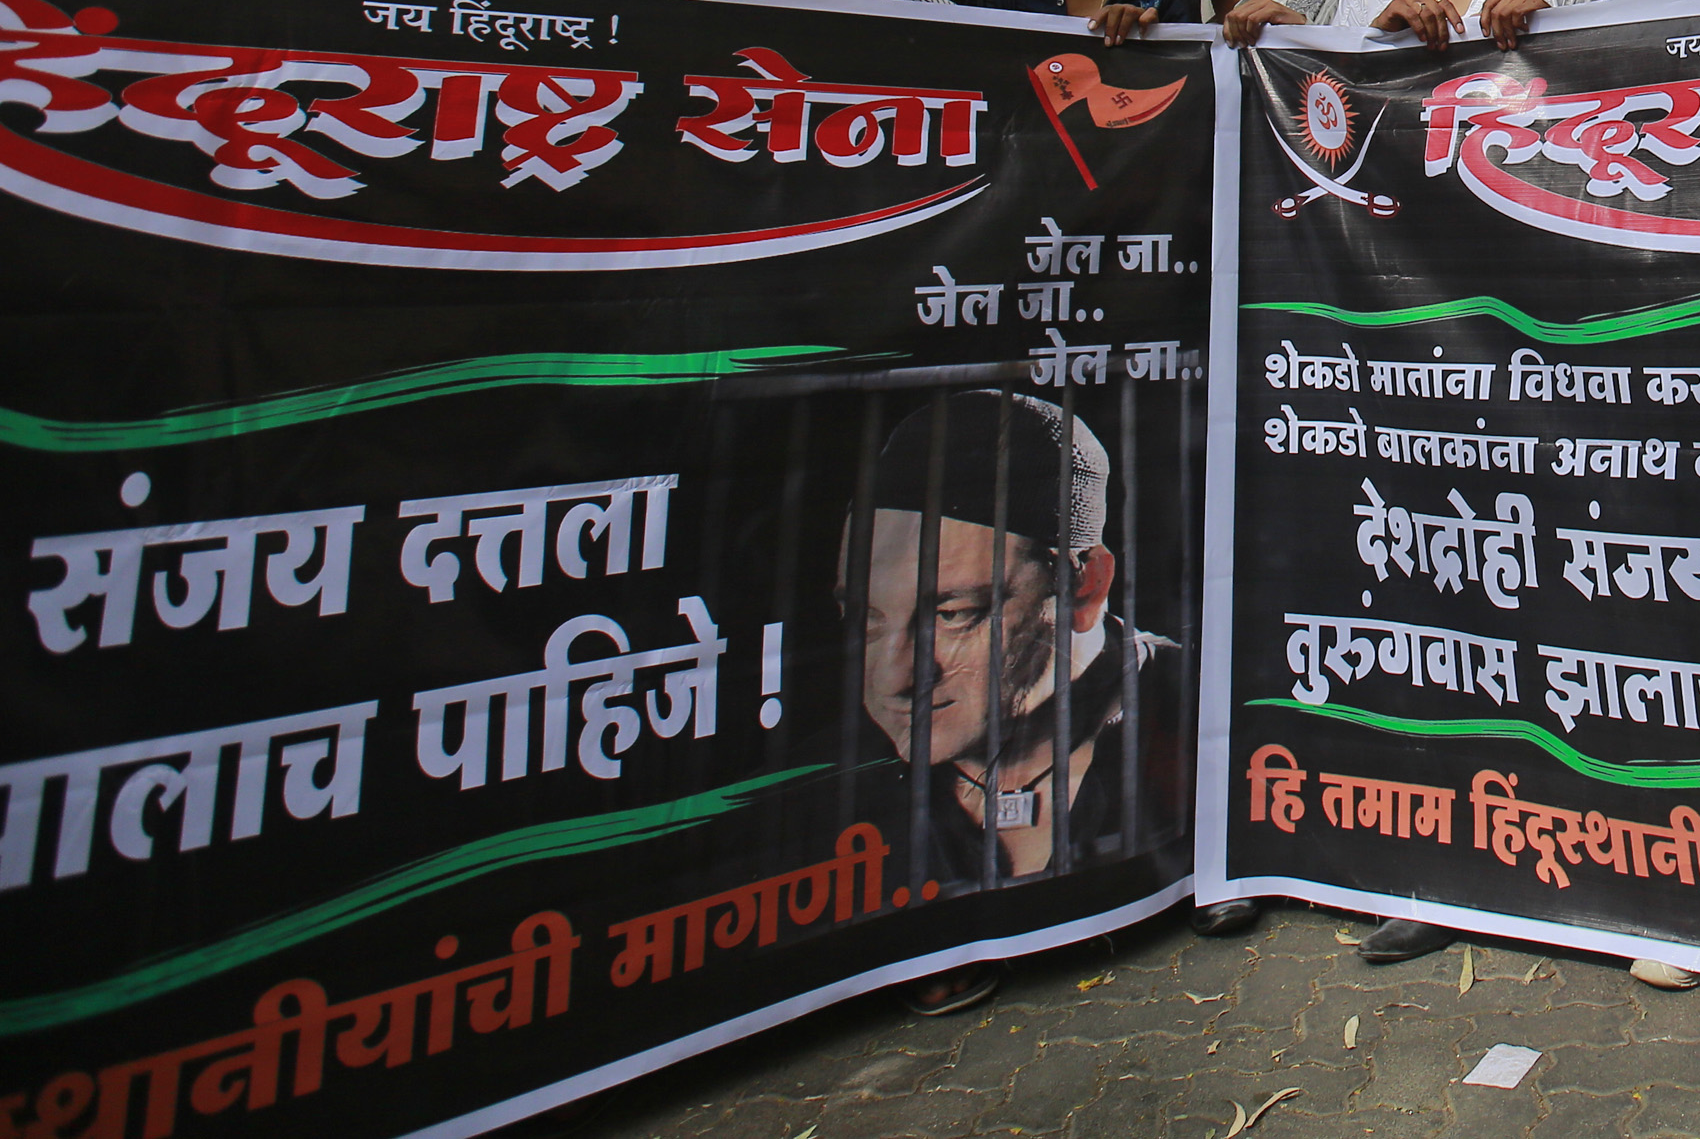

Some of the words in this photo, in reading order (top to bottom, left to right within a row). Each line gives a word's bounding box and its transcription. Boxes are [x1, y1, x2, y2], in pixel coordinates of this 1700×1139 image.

[364, 0, 430, 33] जय
[677, 46, 988, 168] सेना
[1025, 216, 1105, 275] जेल
[1117, 234, 1198, 274] जा..
[915, 265, 1004, 327] जेल
[1018, 281, 1104, 322] जा..
[1029, 327, 1112, 387] जेल
[1124, 340, 1203, 381] जा..
[1264, 341, 1360, 394] शेकडो
[1368, 346, 1495, 401] मातांना
[1507, 349, 1632, 406] विधवा
[1264, 404, 1368, 460] शेकडो
[1376, 418, 1538, 474] बालकांना
[1549, 436, 1679, 482] अनाथ
[27, 471, 366, 656] संजय
[399, 474, 679, 603] दत्तला
[1353, 478, 1540, 609] देशद्रोही
[413, 596, 728, 791] पाहिजे
[1247, 743, 1306, 834] हि
[1319, 771, 1456, 845] तमाम
